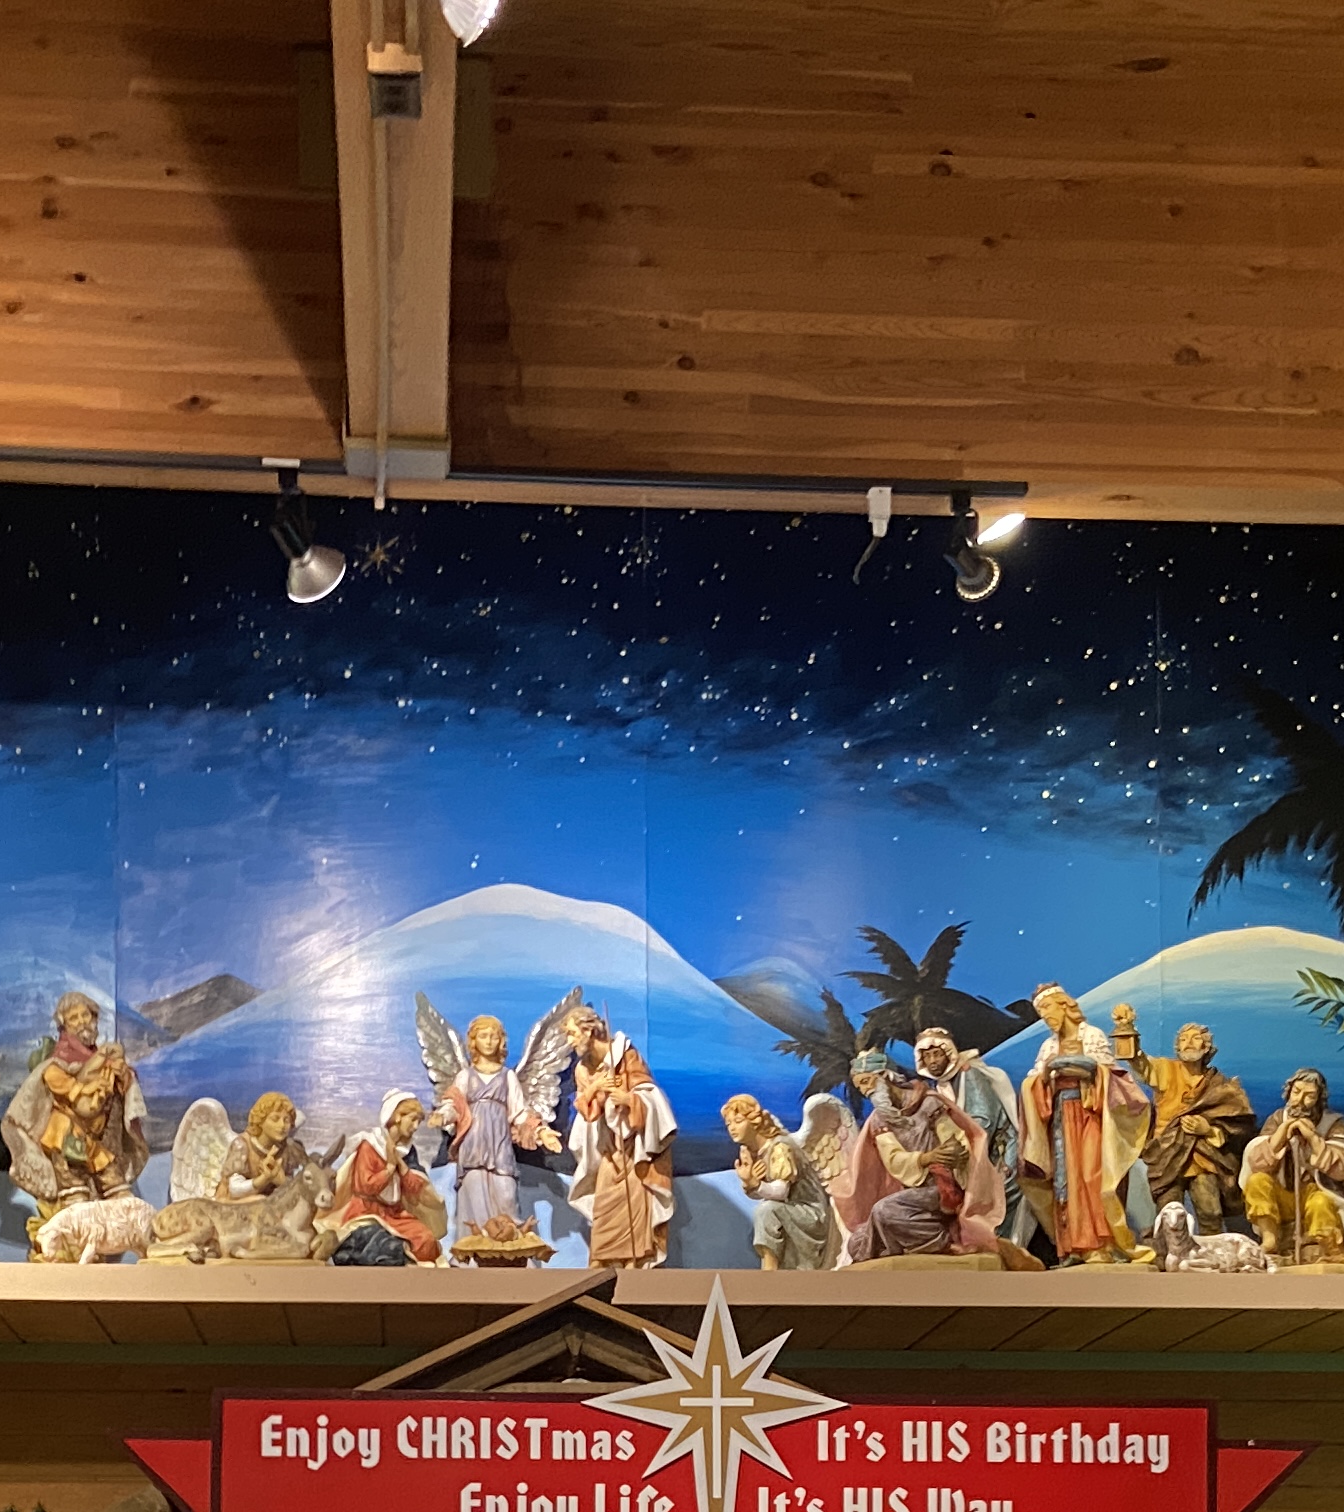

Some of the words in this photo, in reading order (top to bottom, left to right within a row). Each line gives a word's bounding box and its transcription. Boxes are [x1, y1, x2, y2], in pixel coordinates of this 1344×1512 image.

[260, 1413, 381, 1470] Enjoy
[816, 1420, 887, 1462] It's
[901, 1420, 971, 1463] HIS
[985, 1420, 1170, 1473] Birthday
